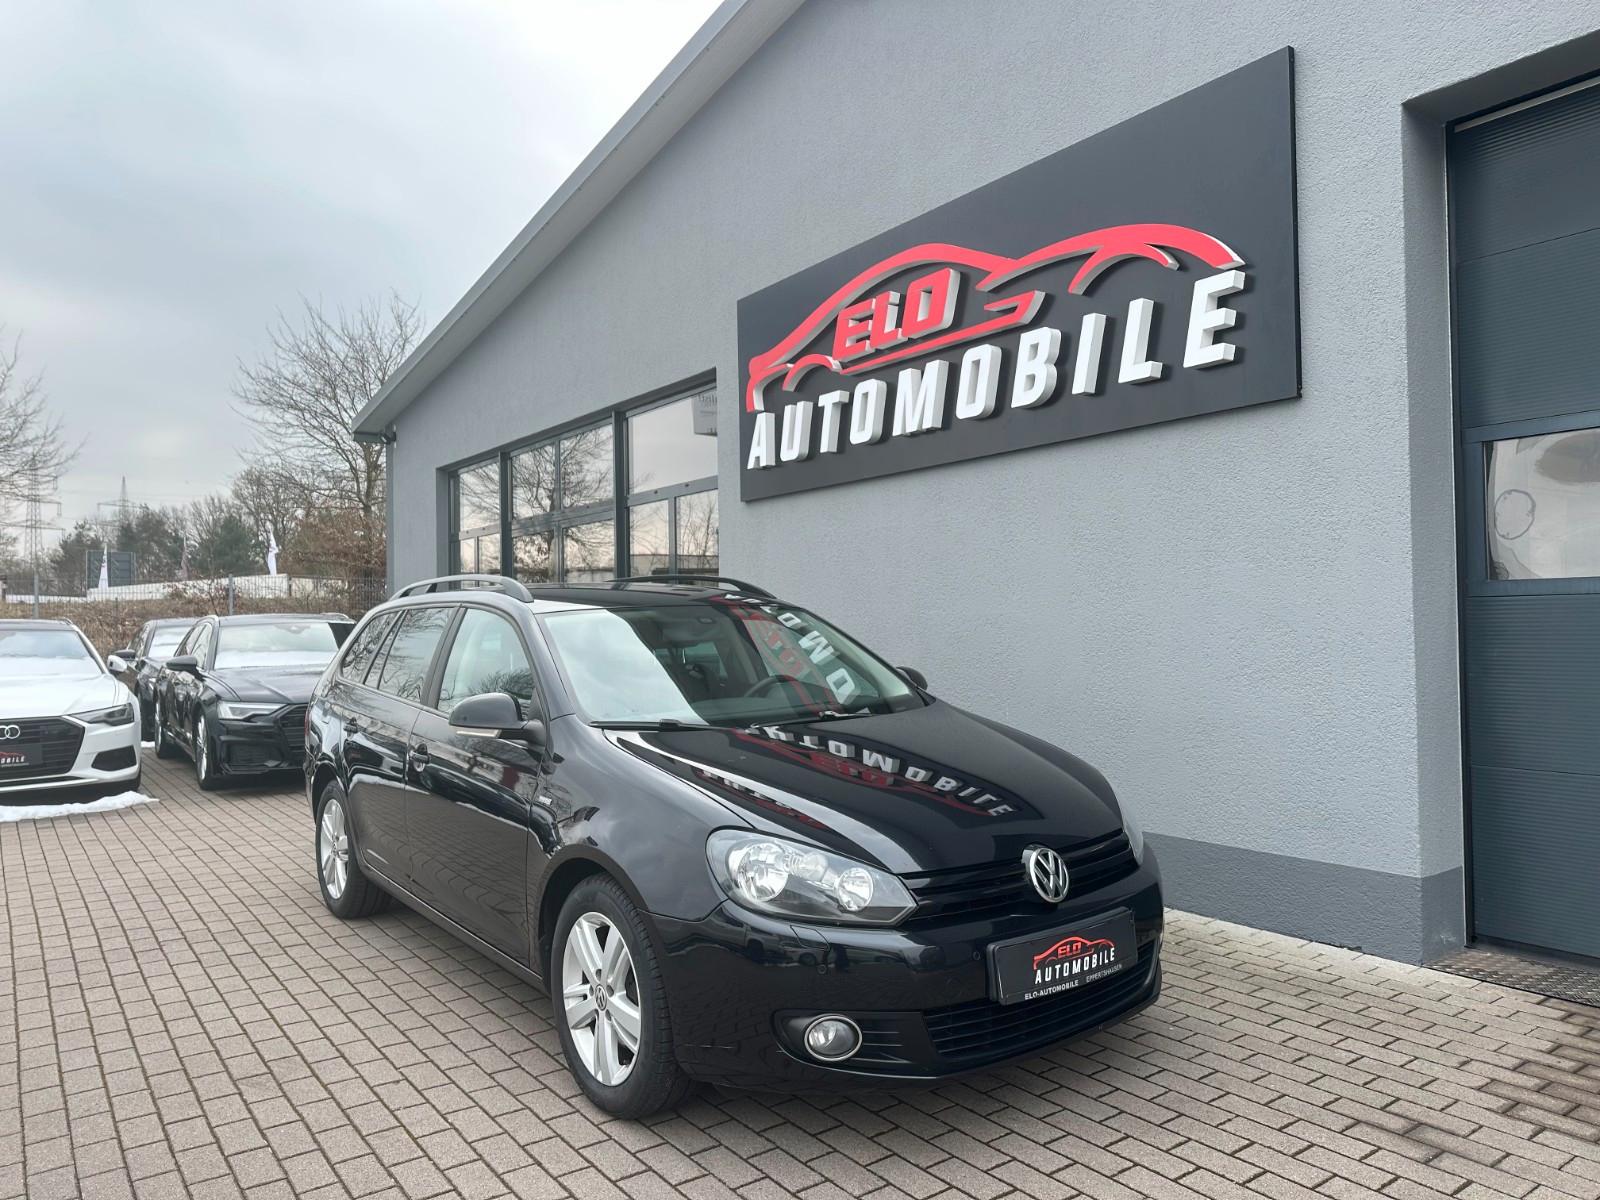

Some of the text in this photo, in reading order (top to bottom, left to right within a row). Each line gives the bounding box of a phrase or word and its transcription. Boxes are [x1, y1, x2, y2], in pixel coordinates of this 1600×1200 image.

[832, 267, 962, 363] ELO
[746, 269, 1246, 470] AUTOMOBILE
[1035, 947, 1115, 985] AUTOMOBILE
[1057, 942, 1082, 958] ELO
[1024, 980, 1079, 1000] ELO-AUTOMOBILE
